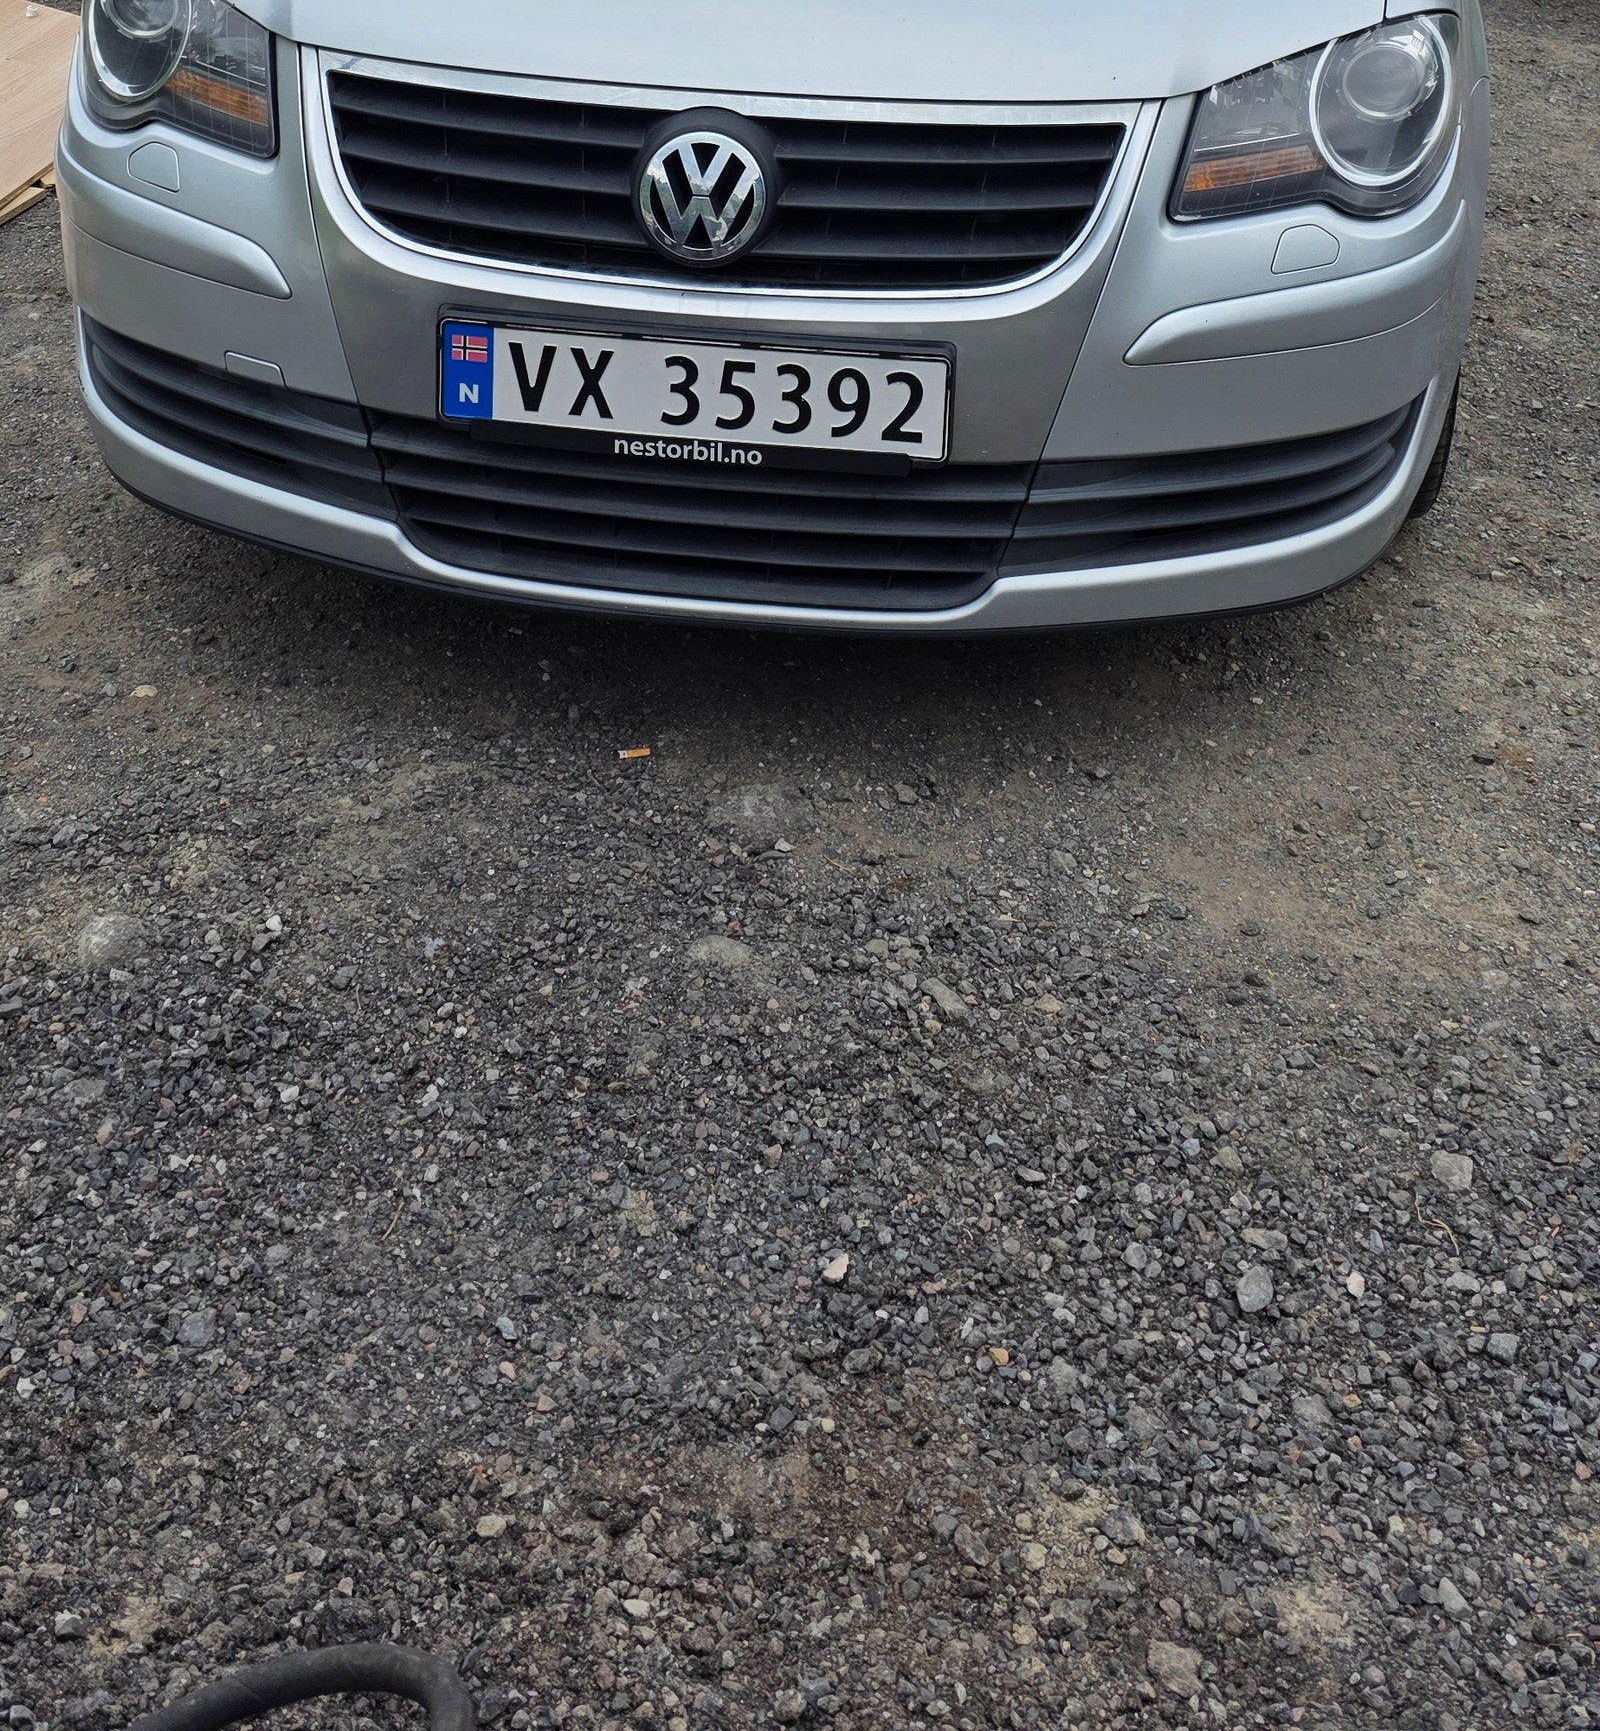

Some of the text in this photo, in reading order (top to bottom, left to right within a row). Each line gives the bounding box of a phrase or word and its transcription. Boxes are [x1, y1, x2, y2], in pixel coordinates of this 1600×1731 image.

[640, 132, 766, 260] VW
[459, 382, 479, 404] N
[508, 342, 925, 444] VX 35392
[613, 437, 763, 466] nestorbil.no
